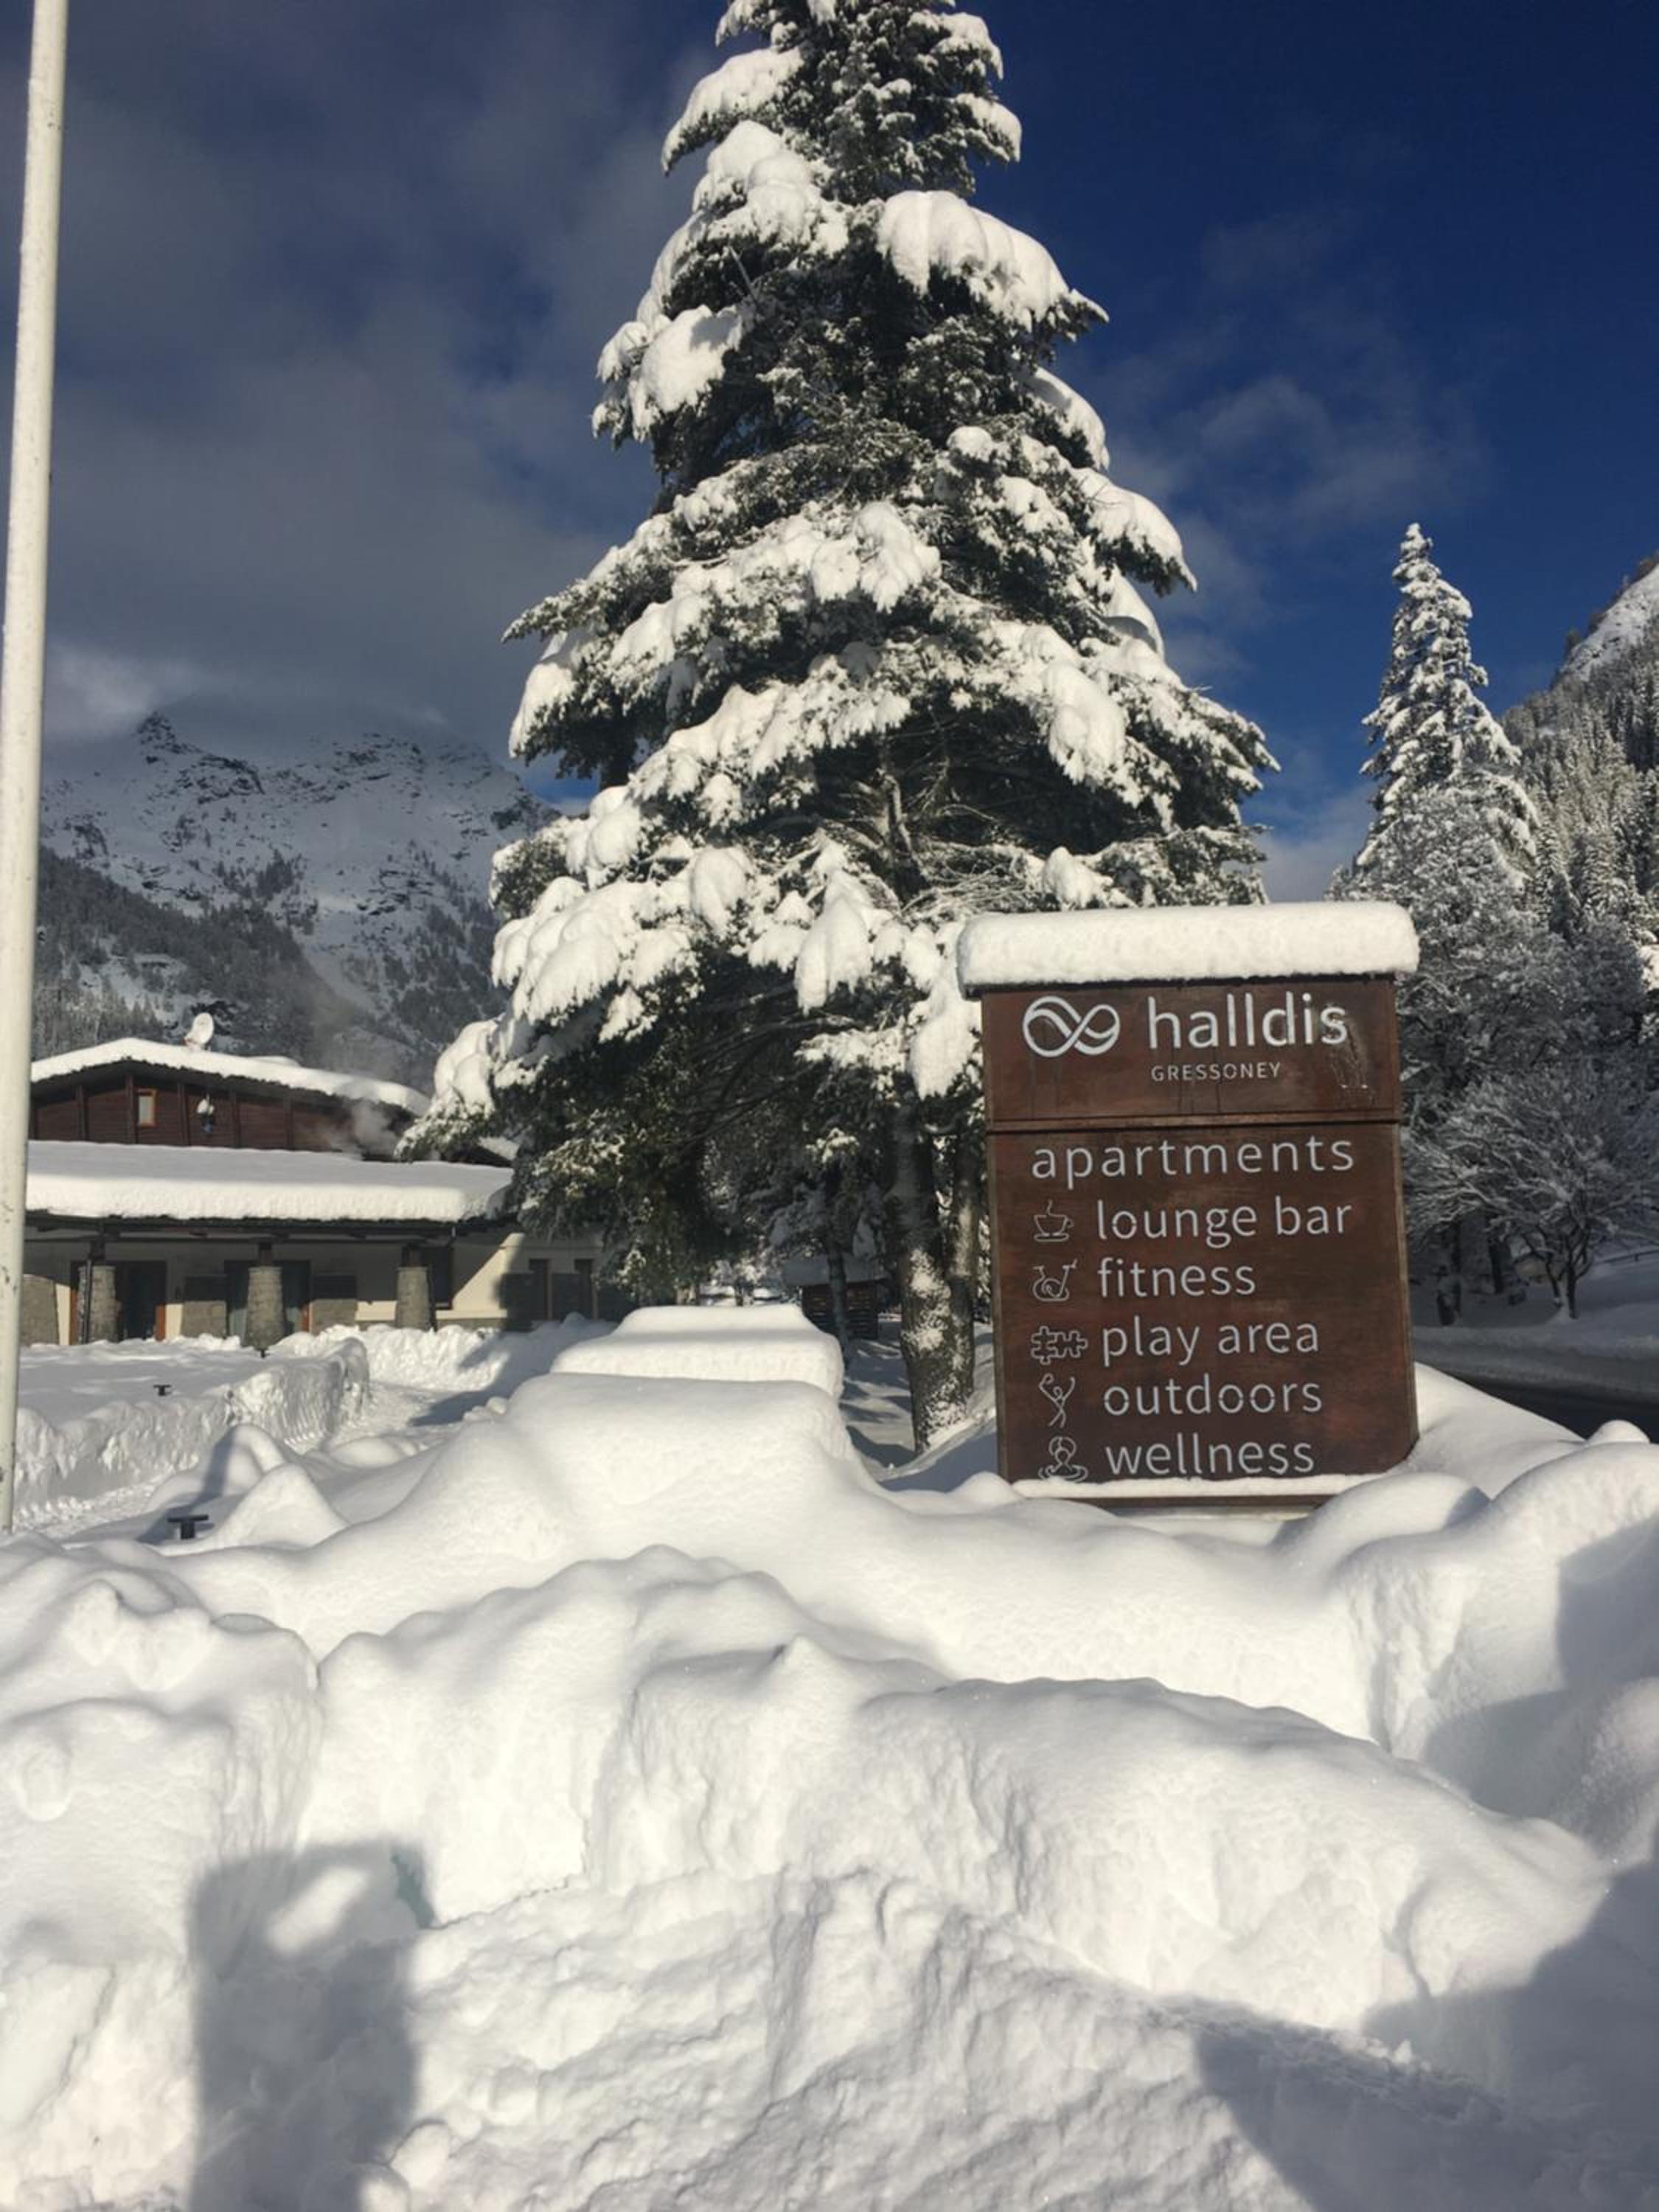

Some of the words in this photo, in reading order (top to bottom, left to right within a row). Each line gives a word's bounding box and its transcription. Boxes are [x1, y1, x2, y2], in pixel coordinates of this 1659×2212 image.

[1148, 990, 1349, 1050] halldis
[1151, 1062, 1281, 1082] GRESSONEY
[1032, 1136, 1354, 1189] apartments
[1098, 1200, 1258, 1249] lounge
[1275, 1195, 1352, 1236] bar
[1097, 1257, 1256, 1298] fitness
[1102, 1315, 1200, 1366] play
[1218, 1321, 1319, 1354] area
[1104, 1374, 1323, 1416] outdoors
[1106, 1433, 1315, 1475] wellness
